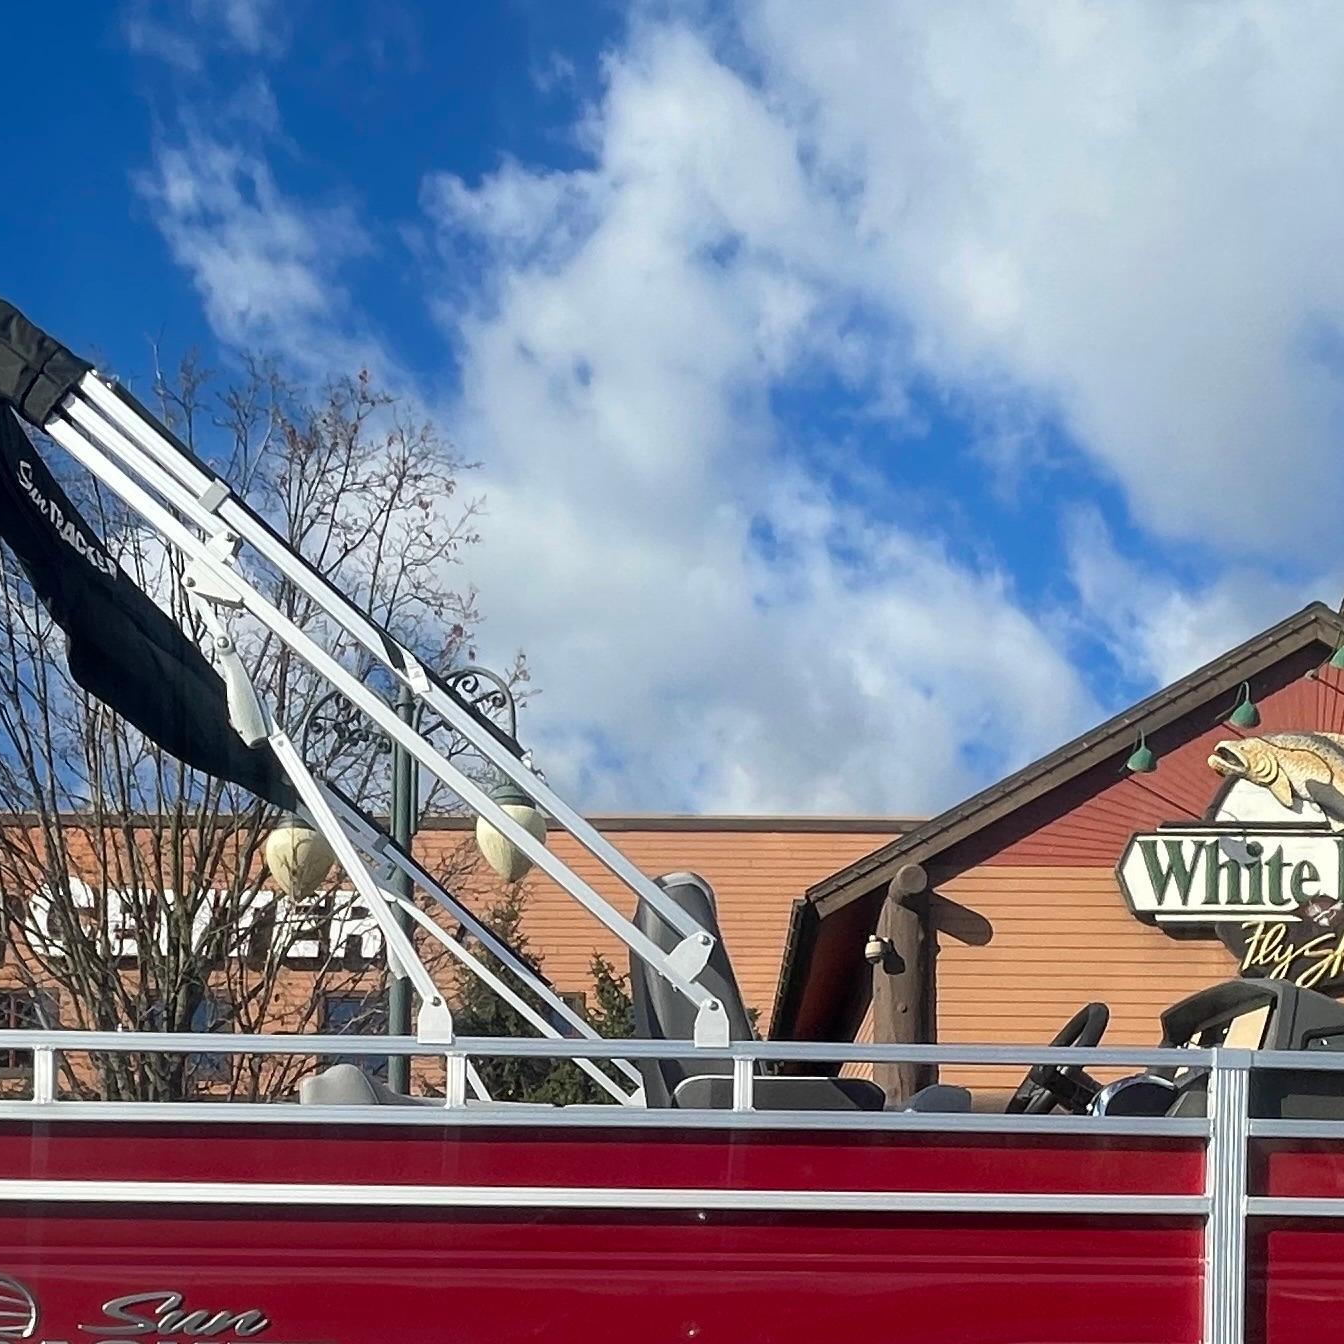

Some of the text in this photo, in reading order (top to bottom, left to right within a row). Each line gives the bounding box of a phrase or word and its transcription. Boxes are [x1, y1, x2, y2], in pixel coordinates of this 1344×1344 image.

[1138, 838, 1322, 907] White
[1239, 921, 1296, 980] Fly
[77, 1290, 272, 1337] Sun
